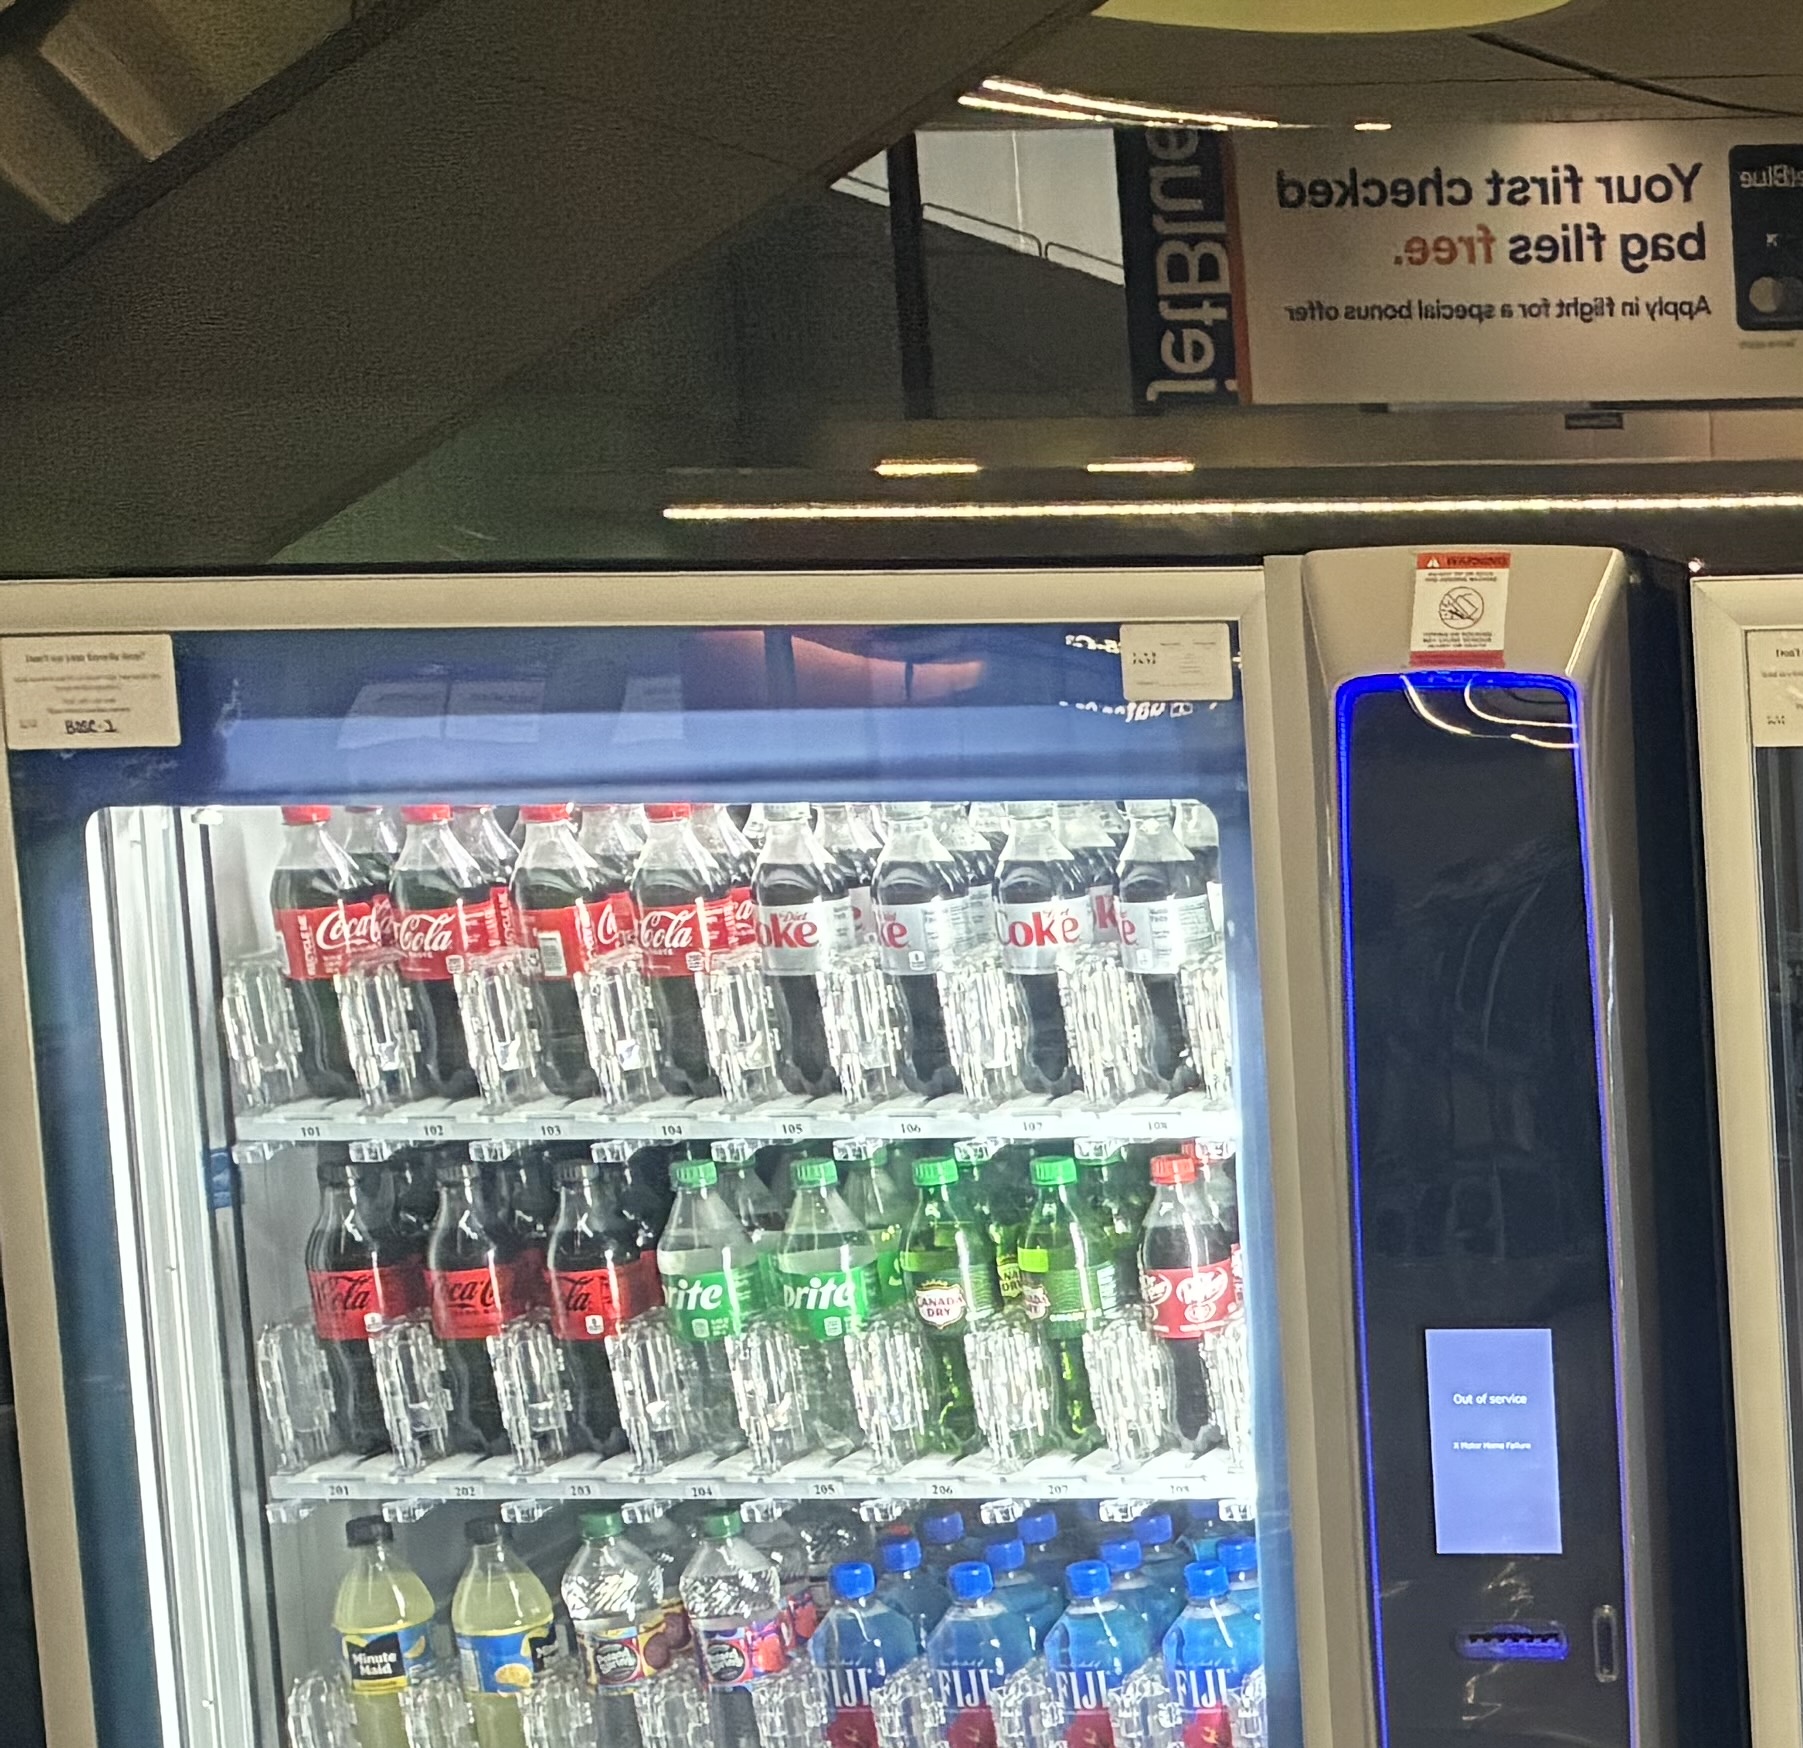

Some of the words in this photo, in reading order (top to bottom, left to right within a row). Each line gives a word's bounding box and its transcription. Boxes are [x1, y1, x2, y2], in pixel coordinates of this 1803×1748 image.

[541, 1125, 561, 1137] 103
[661, 1125, 682, 1137] 104
[782, 1125, 803, 1137] 105
[915, 1294, 963, 1306] CANADA
[926, 1306, 952, 1318] DRY
[1453, 1393, 1472, 1405] Out
[1476, 1393, 1487, 1404] of
[1489, 1394, 1527, 1404] service
[813, 1483, 835, 1495] 205
[932, 1483, 954, 1495] 206
[351, 1653, 396, 1665] Minute
[359, 1663, 392, 1676] Maid
